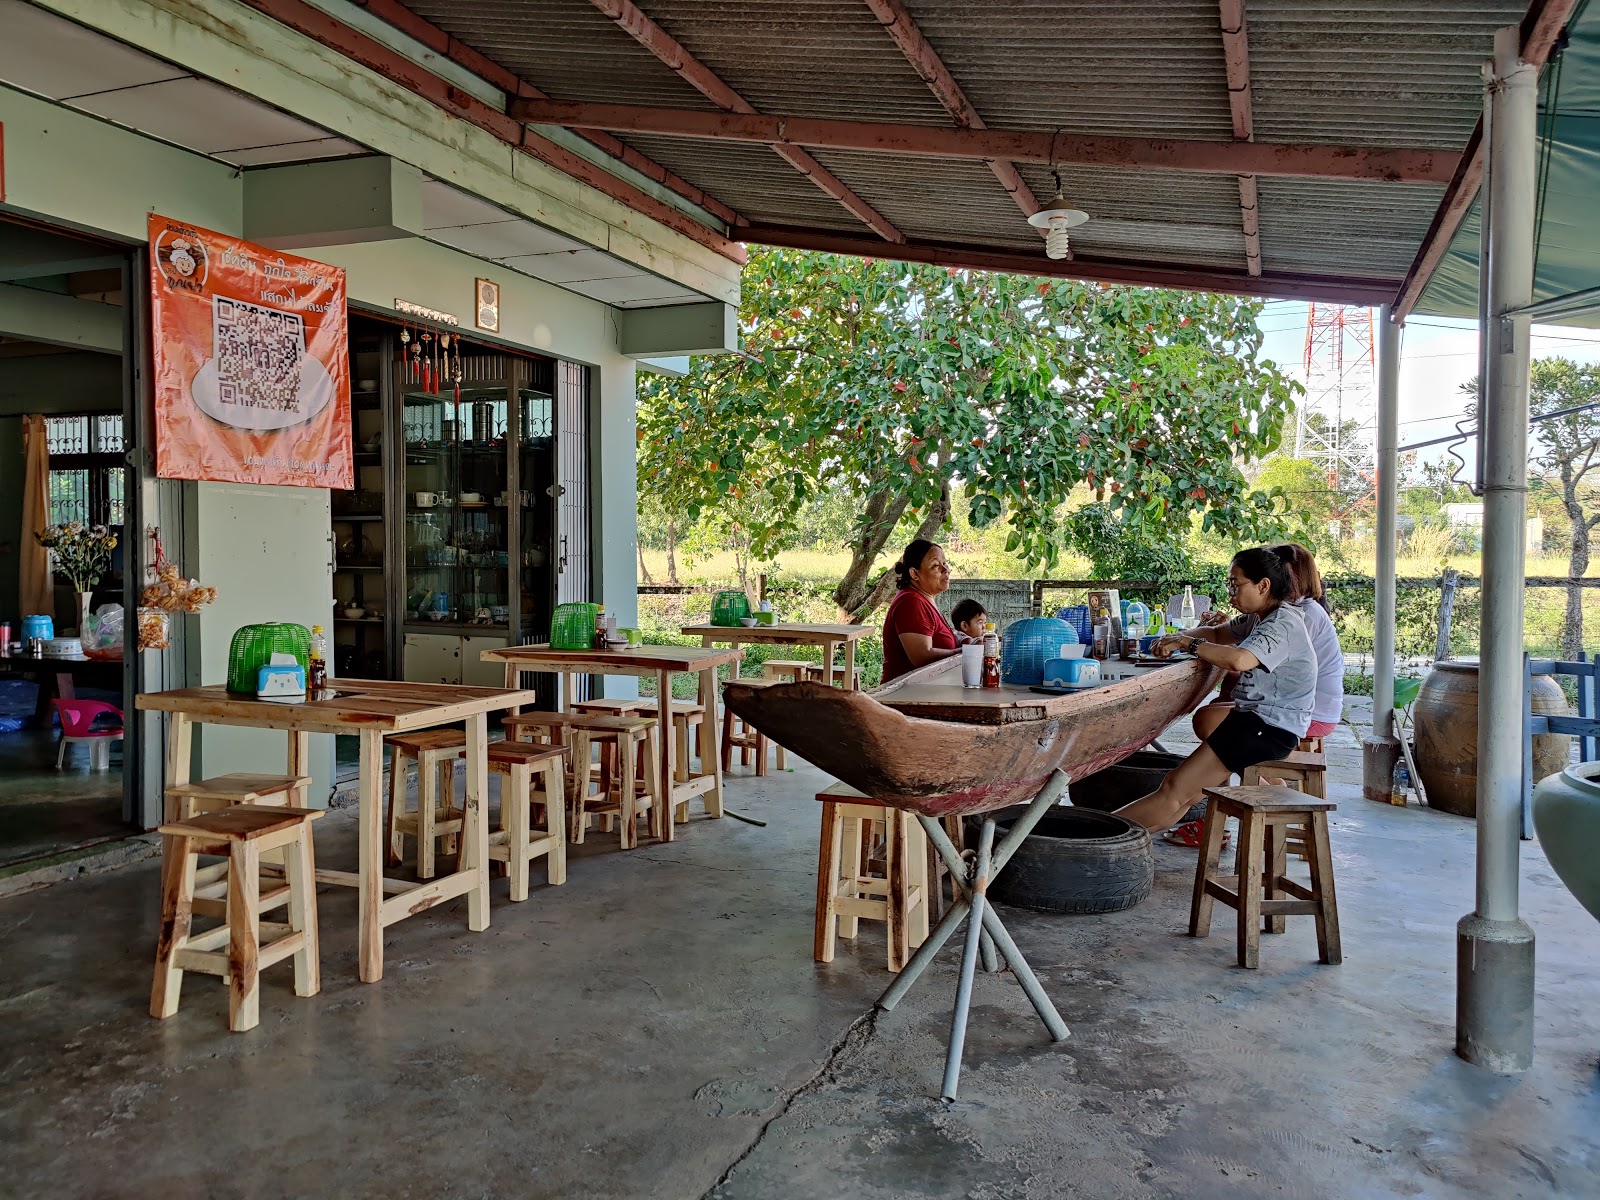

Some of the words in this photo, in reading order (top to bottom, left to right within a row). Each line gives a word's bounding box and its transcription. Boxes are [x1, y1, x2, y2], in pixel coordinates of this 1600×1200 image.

[264, 258, 291, 284] ถูกใจ
[260, 284, 336, 313] แสกนได้เลยจ้
